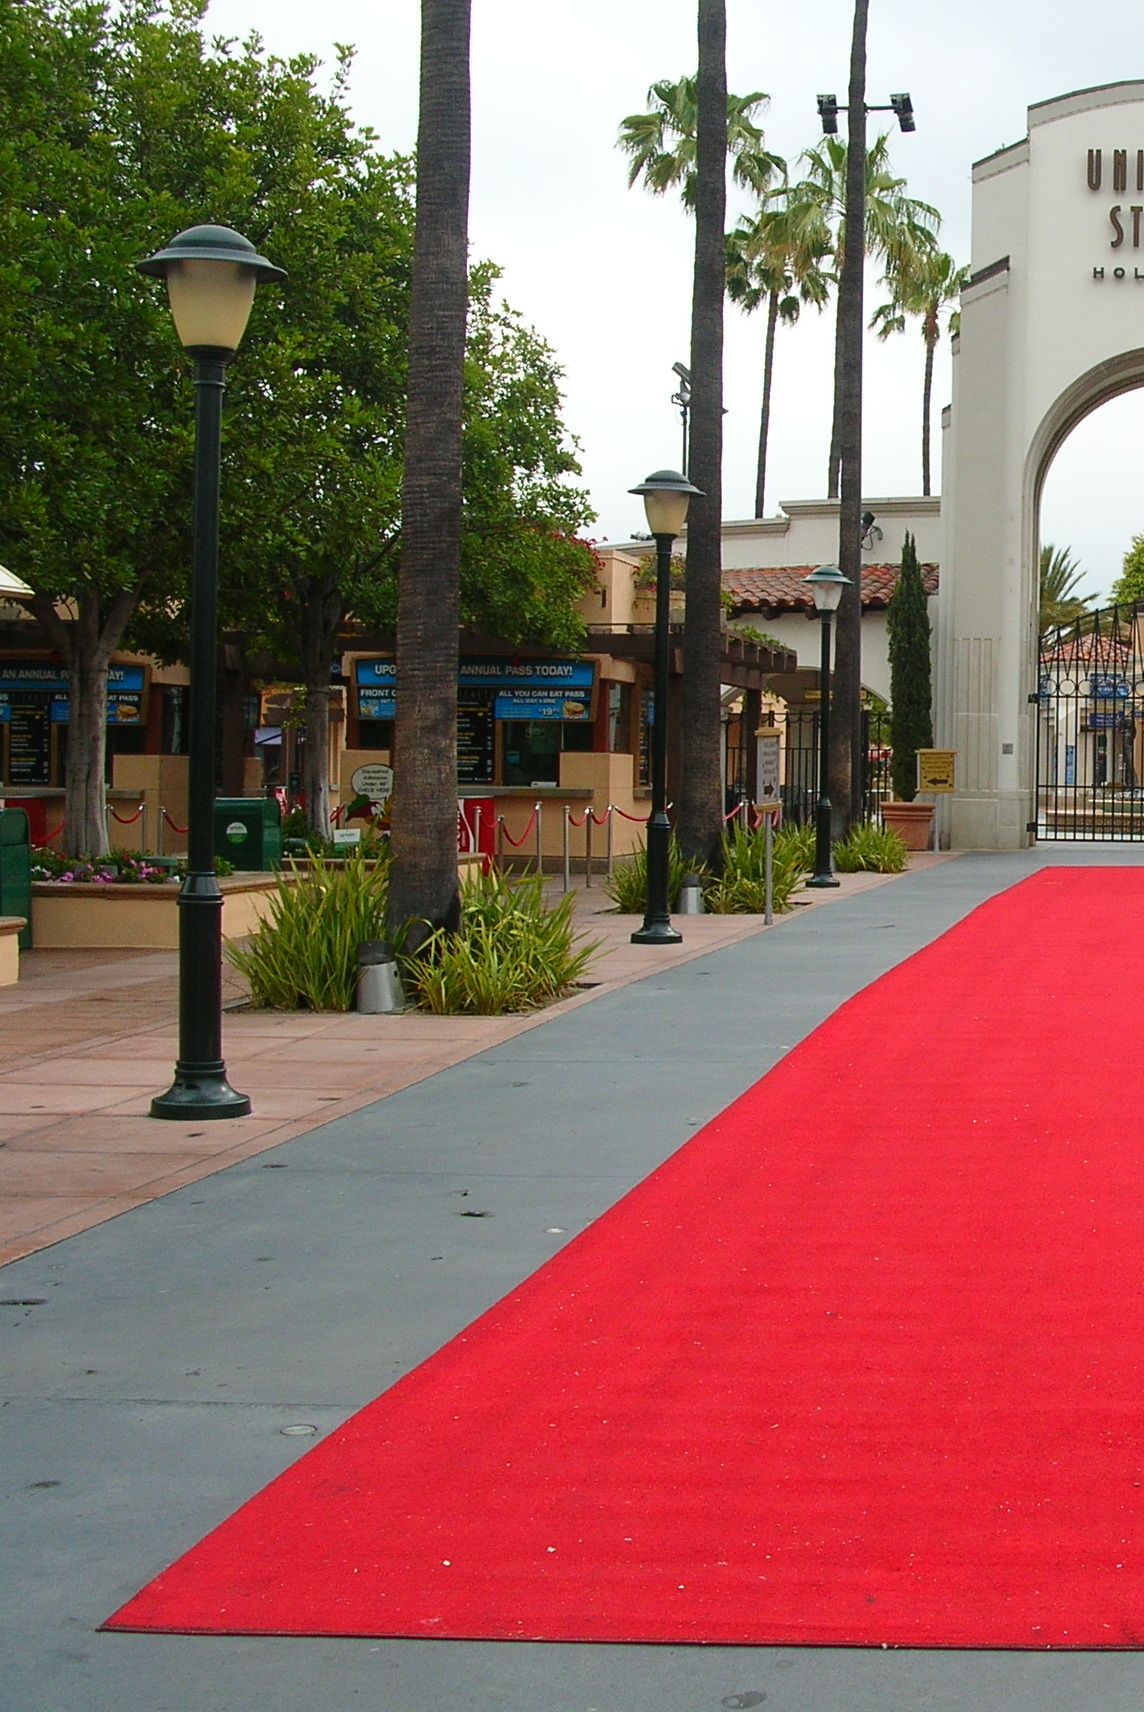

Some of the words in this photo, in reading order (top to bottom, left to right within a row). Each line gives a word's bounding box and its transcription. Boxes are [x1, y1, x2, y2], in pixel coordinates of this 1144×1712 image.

[2, 670, 16, 679] AN
[18, 670, 57, 679] ANNUAL
[375, 665, 397, 675] UPG
[460, 666, 501, 675] ANNUAL
[505, 667, 532, 675] PASS
[535, 666, 573, 676] TODAY!
[360, 689, 389, 697] FRONT
